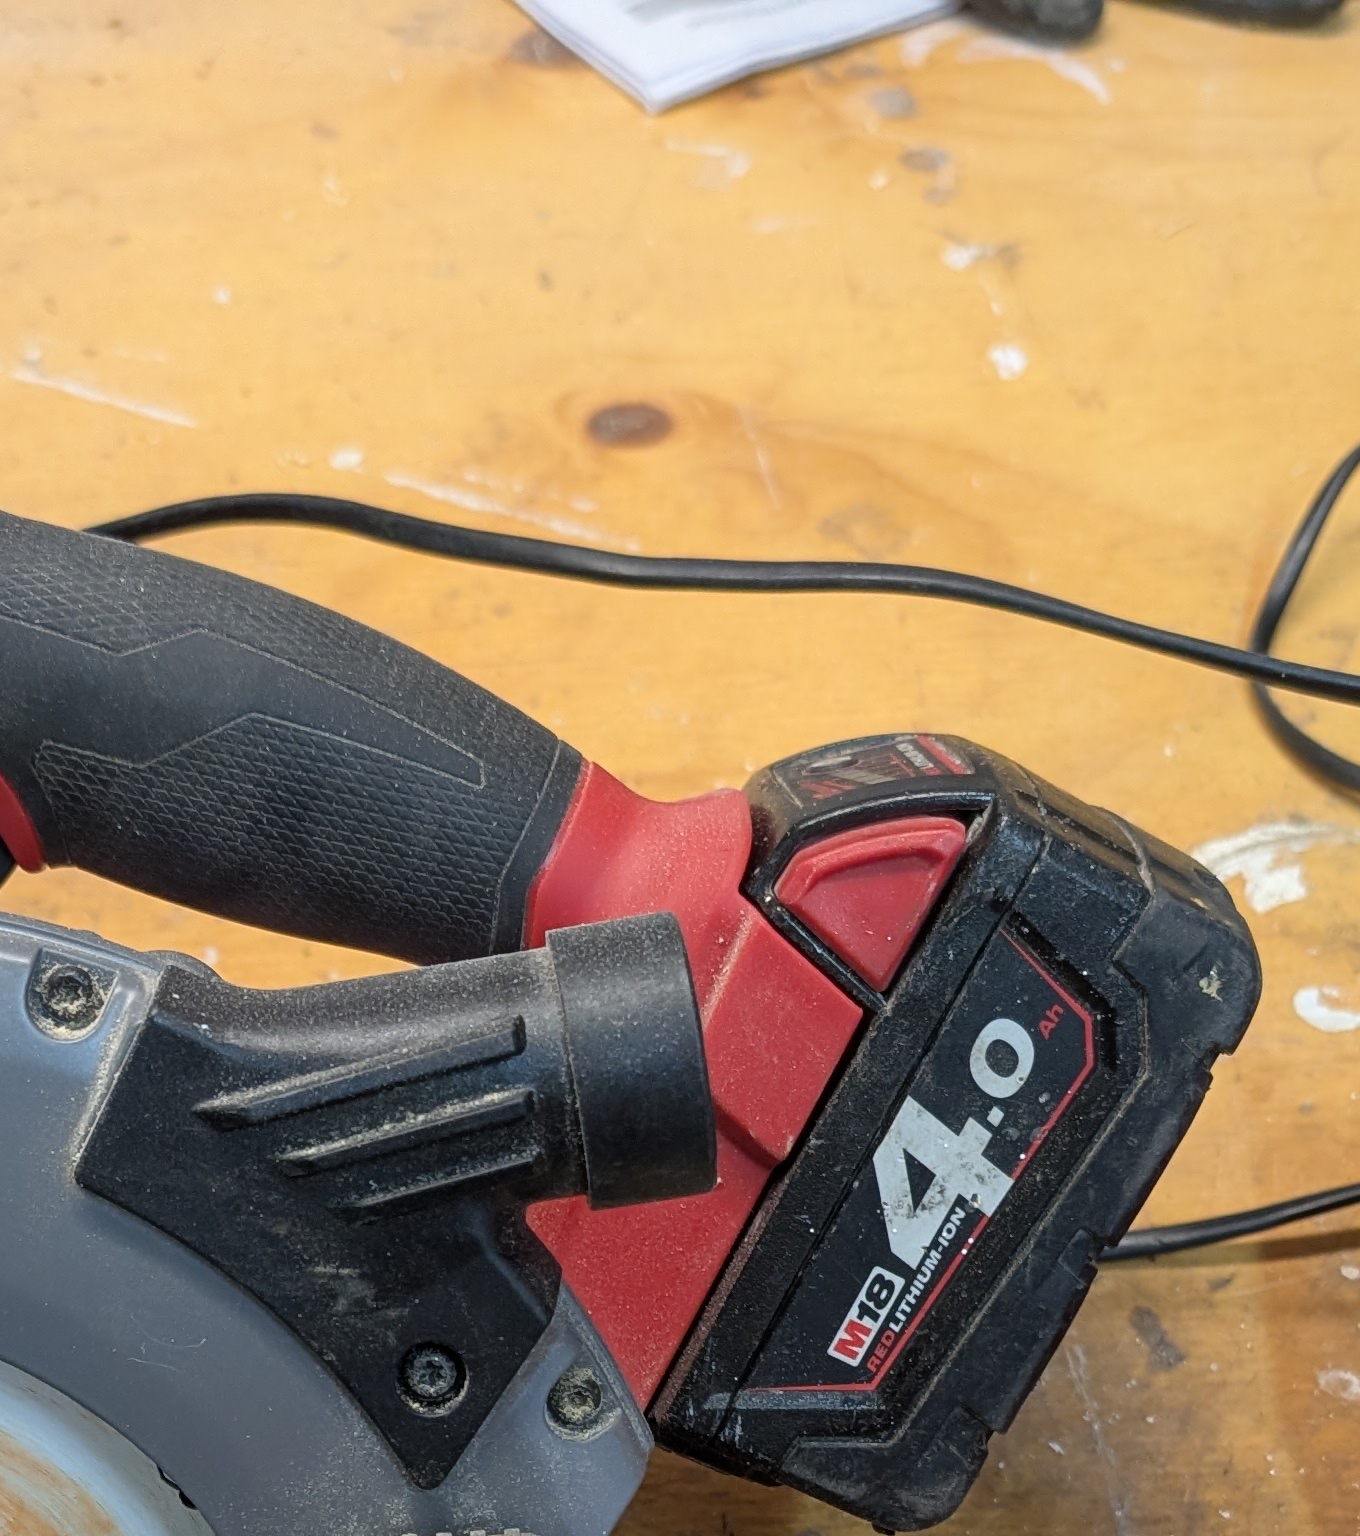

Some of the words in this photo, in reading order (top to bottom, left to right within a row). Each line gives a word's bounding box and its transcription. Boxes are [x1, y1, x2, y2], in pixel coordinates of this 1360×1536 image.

[872, 1018, 1035, 1270] 4.0
[1038, 1004, 1064, 1041] Ah
[833, 1274, 896, 1362] M18
